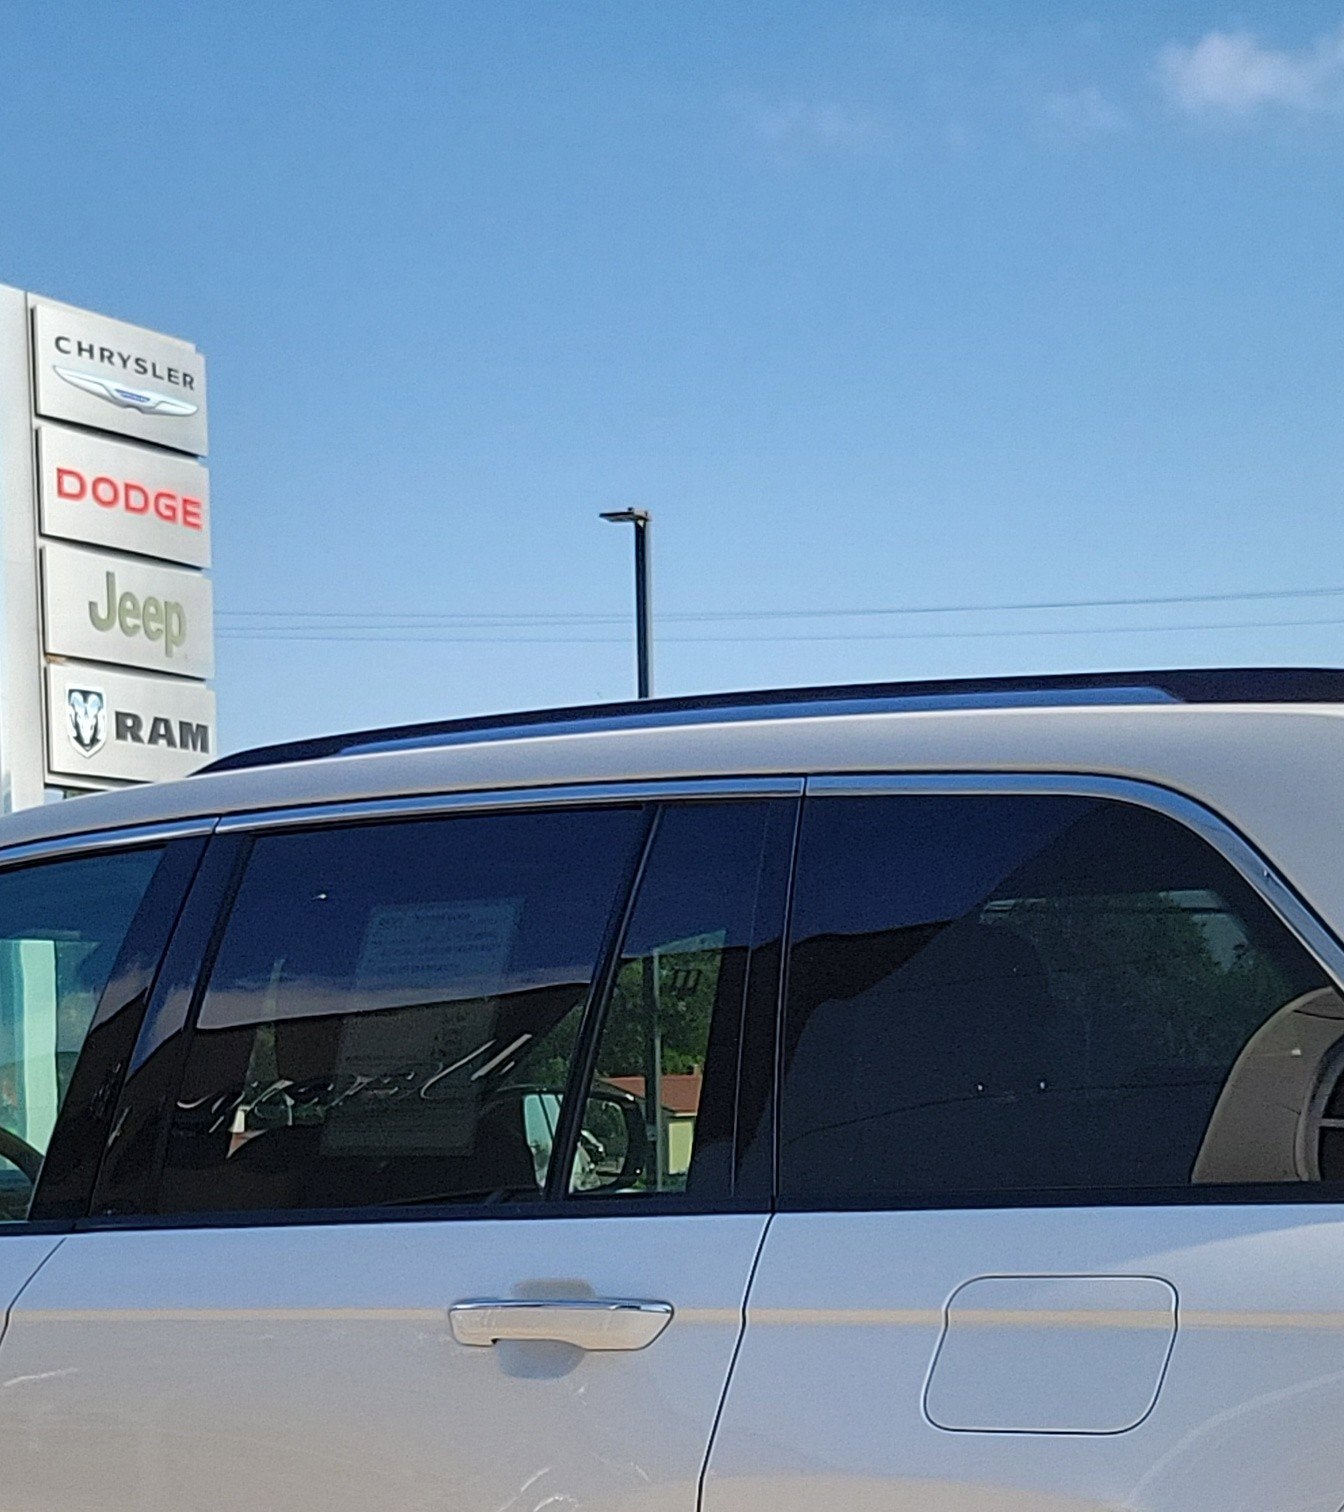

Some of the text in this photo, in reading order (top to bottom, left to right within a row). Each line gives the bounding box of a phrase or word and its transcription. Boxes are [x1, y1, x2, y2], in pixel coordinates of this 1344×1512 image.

[54, 335, 196, 391] CHRYSLER
[56, 467, 203, 531] DODGE
[88, 571, 187, 657] Jeep
[114, 710, 210, 754] RAM
